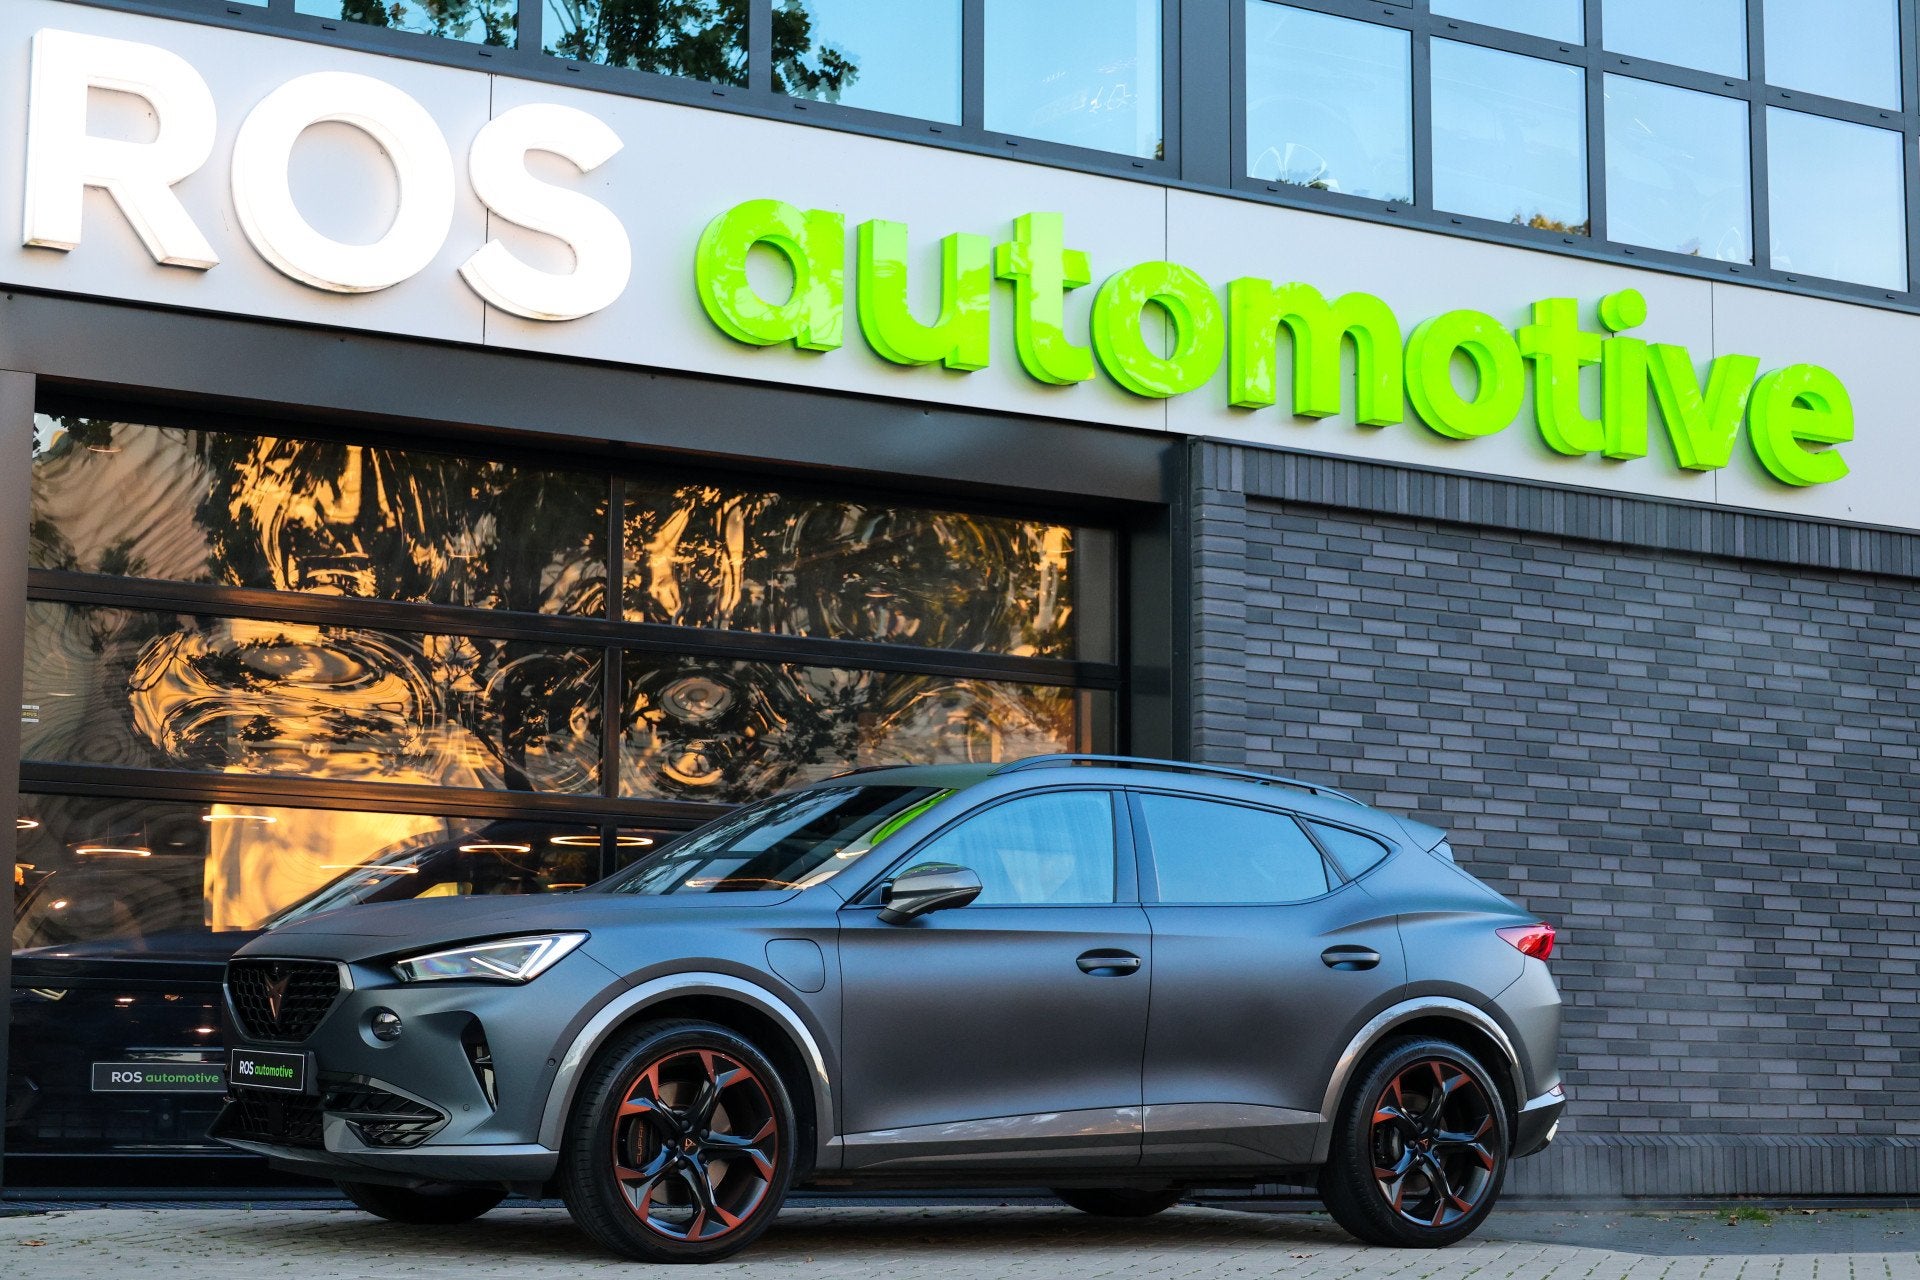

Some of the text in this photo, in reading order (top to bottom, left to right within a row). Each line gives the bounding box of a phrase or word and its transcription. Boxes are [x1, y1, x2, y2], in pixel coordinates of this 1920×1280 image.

[23, 28, 1855, 487] ROS automotive
[111, 1071, 219, 1083] ROS automotive
[239, 1060, 294, 1078] ROS automotive
